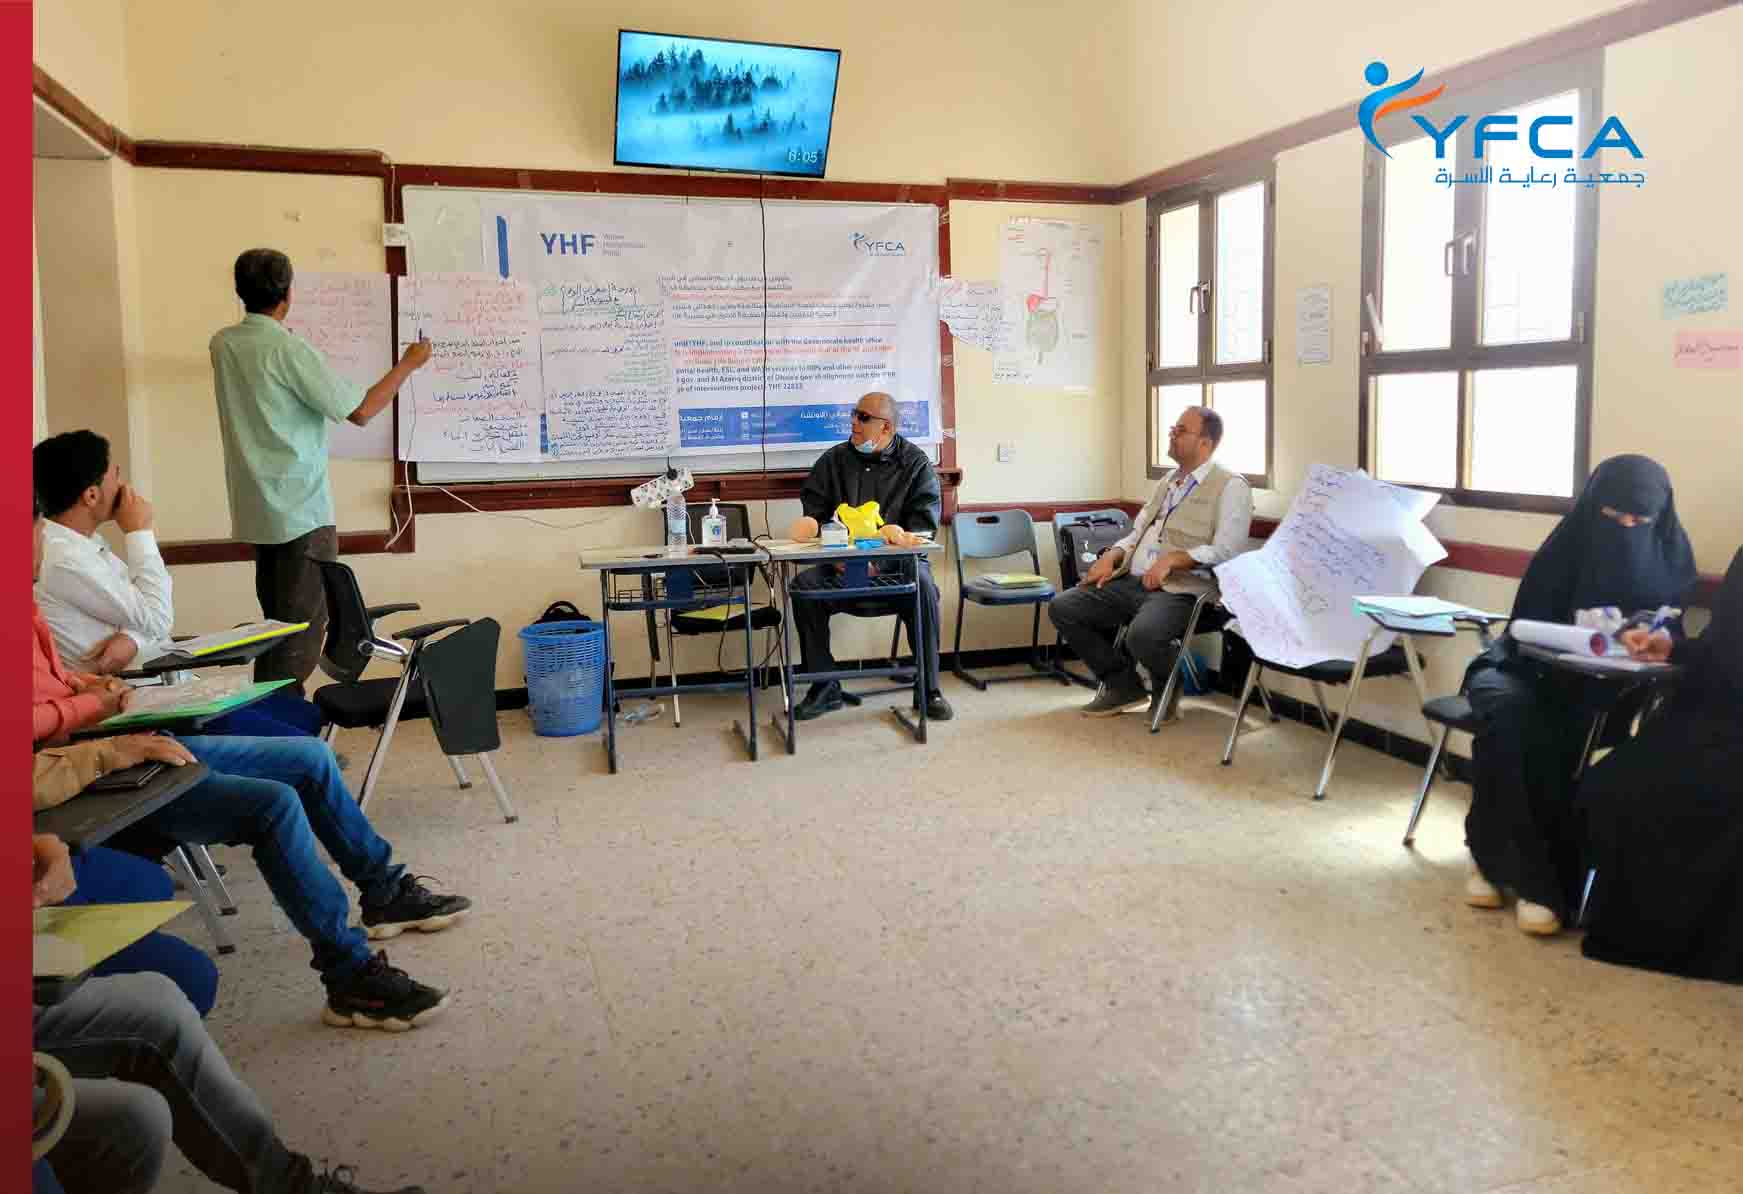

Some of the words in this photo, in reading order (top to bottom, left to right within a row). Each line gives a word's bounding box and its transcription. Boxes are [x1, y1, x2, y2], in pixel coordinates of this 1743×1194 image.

[788, 150, 817, 164] 6:05
[540, 232, 595, 255] YHF
[865, 241, 905, 251] YFCA
